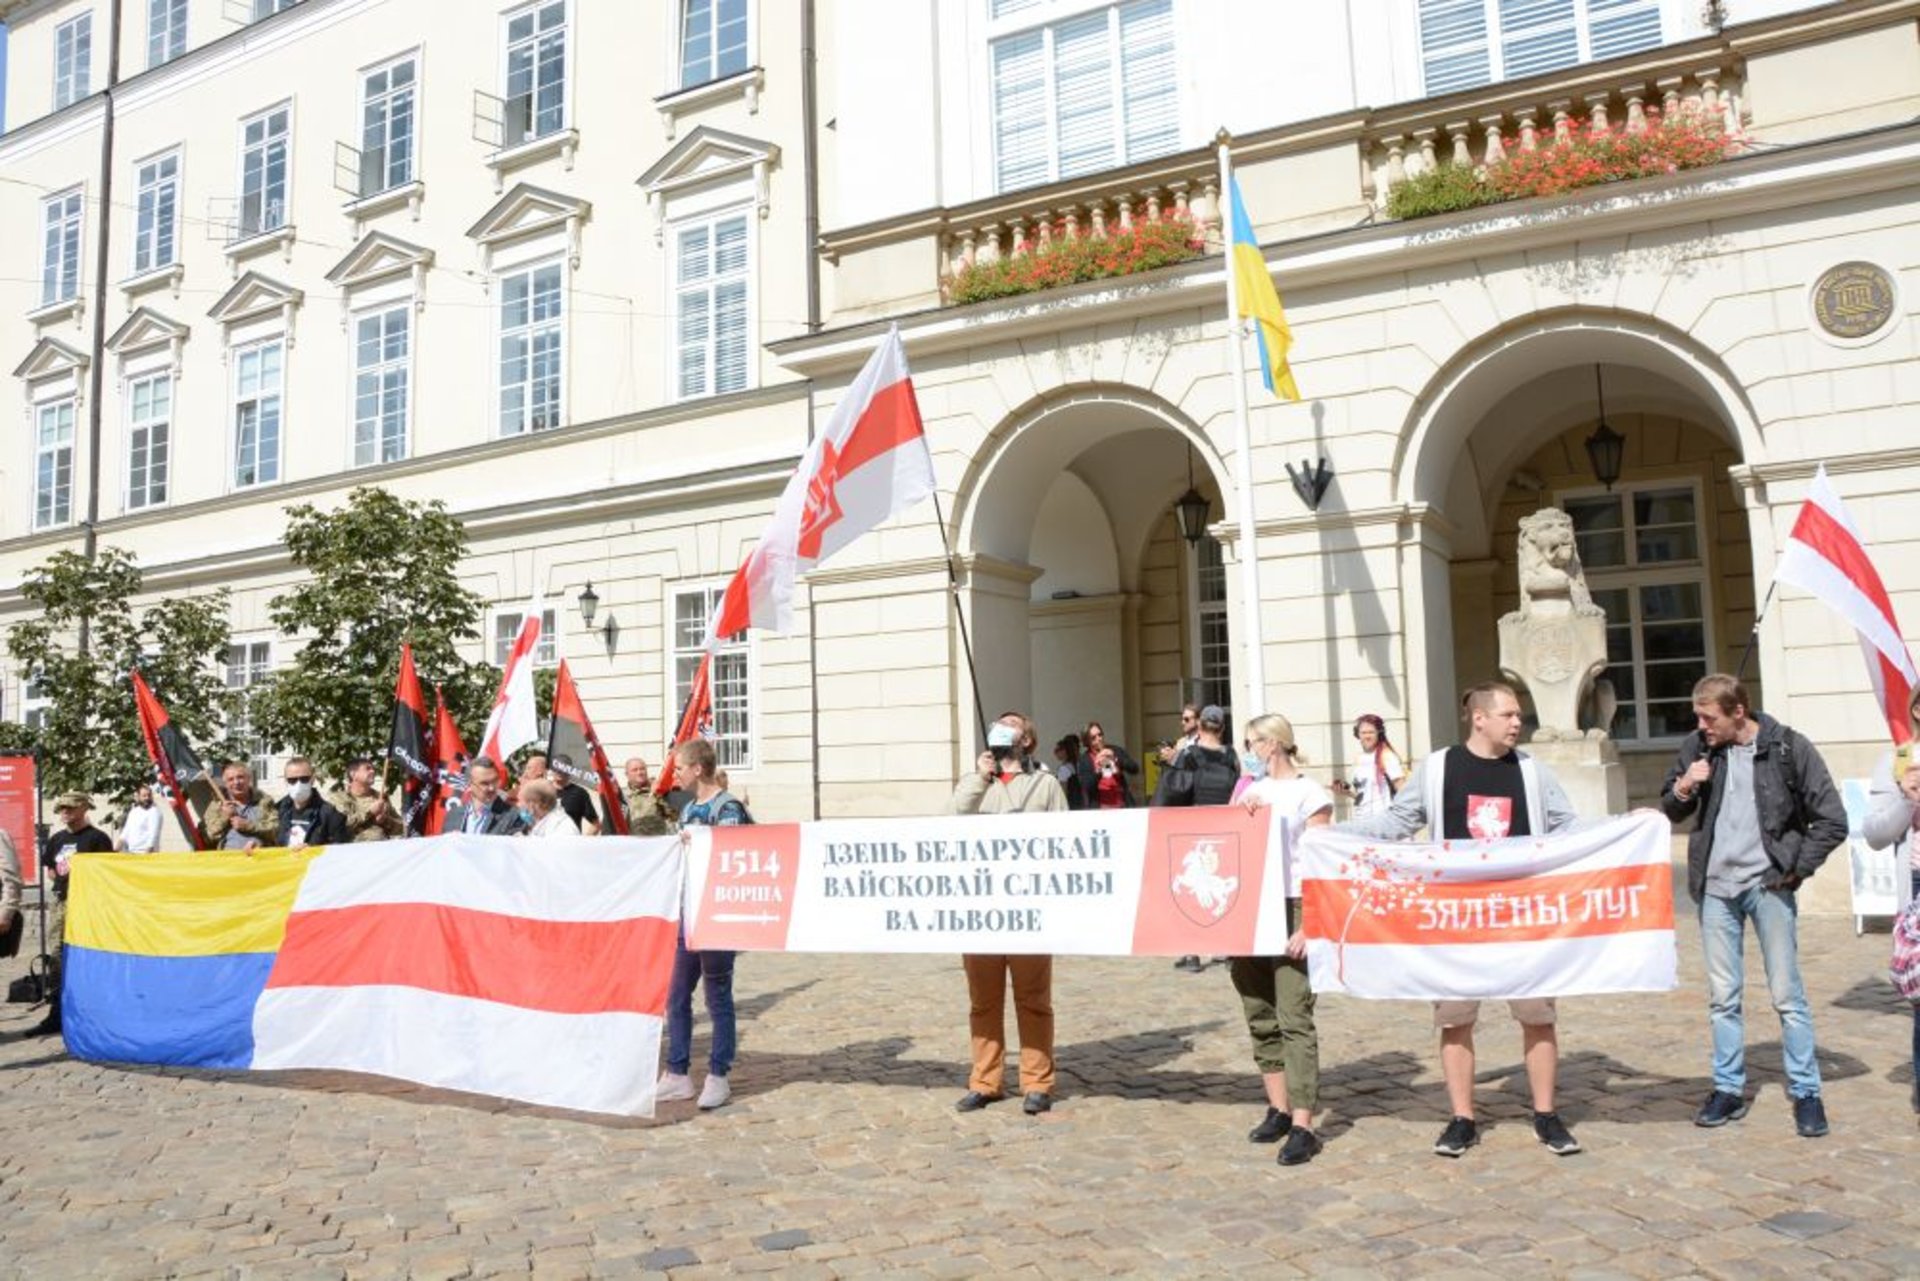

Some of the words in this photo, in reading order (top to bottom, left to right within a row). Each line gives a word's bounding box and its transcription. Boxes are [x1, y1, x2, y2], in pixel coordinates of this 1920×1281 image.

[822, 842, 907, 868] ДЗЕНЬ
[916, 829, 1111, 863] БЕЛАРУСКАЙ
[719, 849, 781, 879] 1514
[714, 884, 783, 903] ВОРША
[824, 868, 993, 898] ВАЙСКОВАЙ
[1003, 871, 1113, 897] СЛАВЫ
[886, 909, 919, 930] ВА
[927, 908, 1042, 931] ЛЬВОВЕ
[1416, 892, 1568, 930] ЗЯЛЁНЫ
[1580, 885, 1648, 922] ЛУГ
